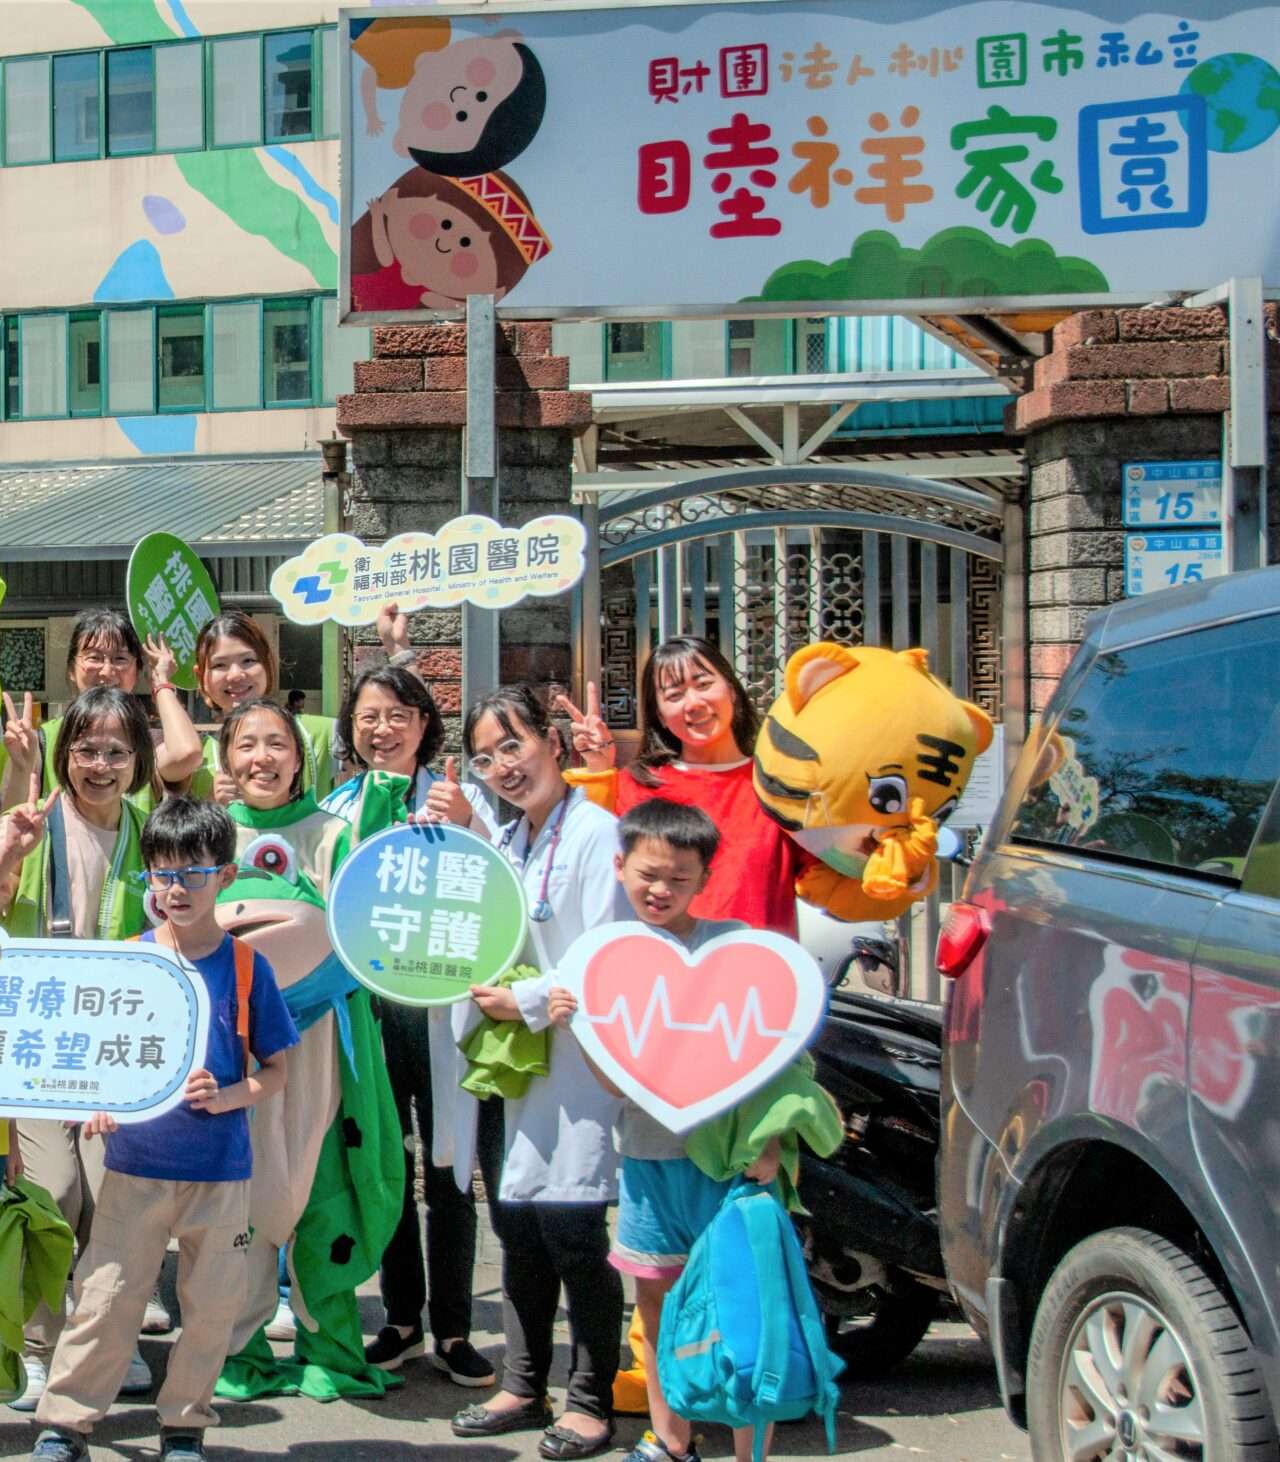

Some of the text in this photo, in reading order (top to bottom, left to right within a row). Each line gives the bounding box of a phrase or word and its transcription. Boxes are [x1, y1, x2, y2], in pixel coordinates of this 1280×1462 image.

[648, 22, 1200, 105] 財團法人桃園市私立
[638, 94, 1208, 240] 睦祥家園
[1155, 492, 1195, 520] 15
[353, 552, 407, 574] 衛生
[353, 568, 408, 592] 福利部
[408, 533, 560, 582] 桃園醫院
[376, 845, 489, 903] 桃醫
[370, 904, 482, 961] 守護
